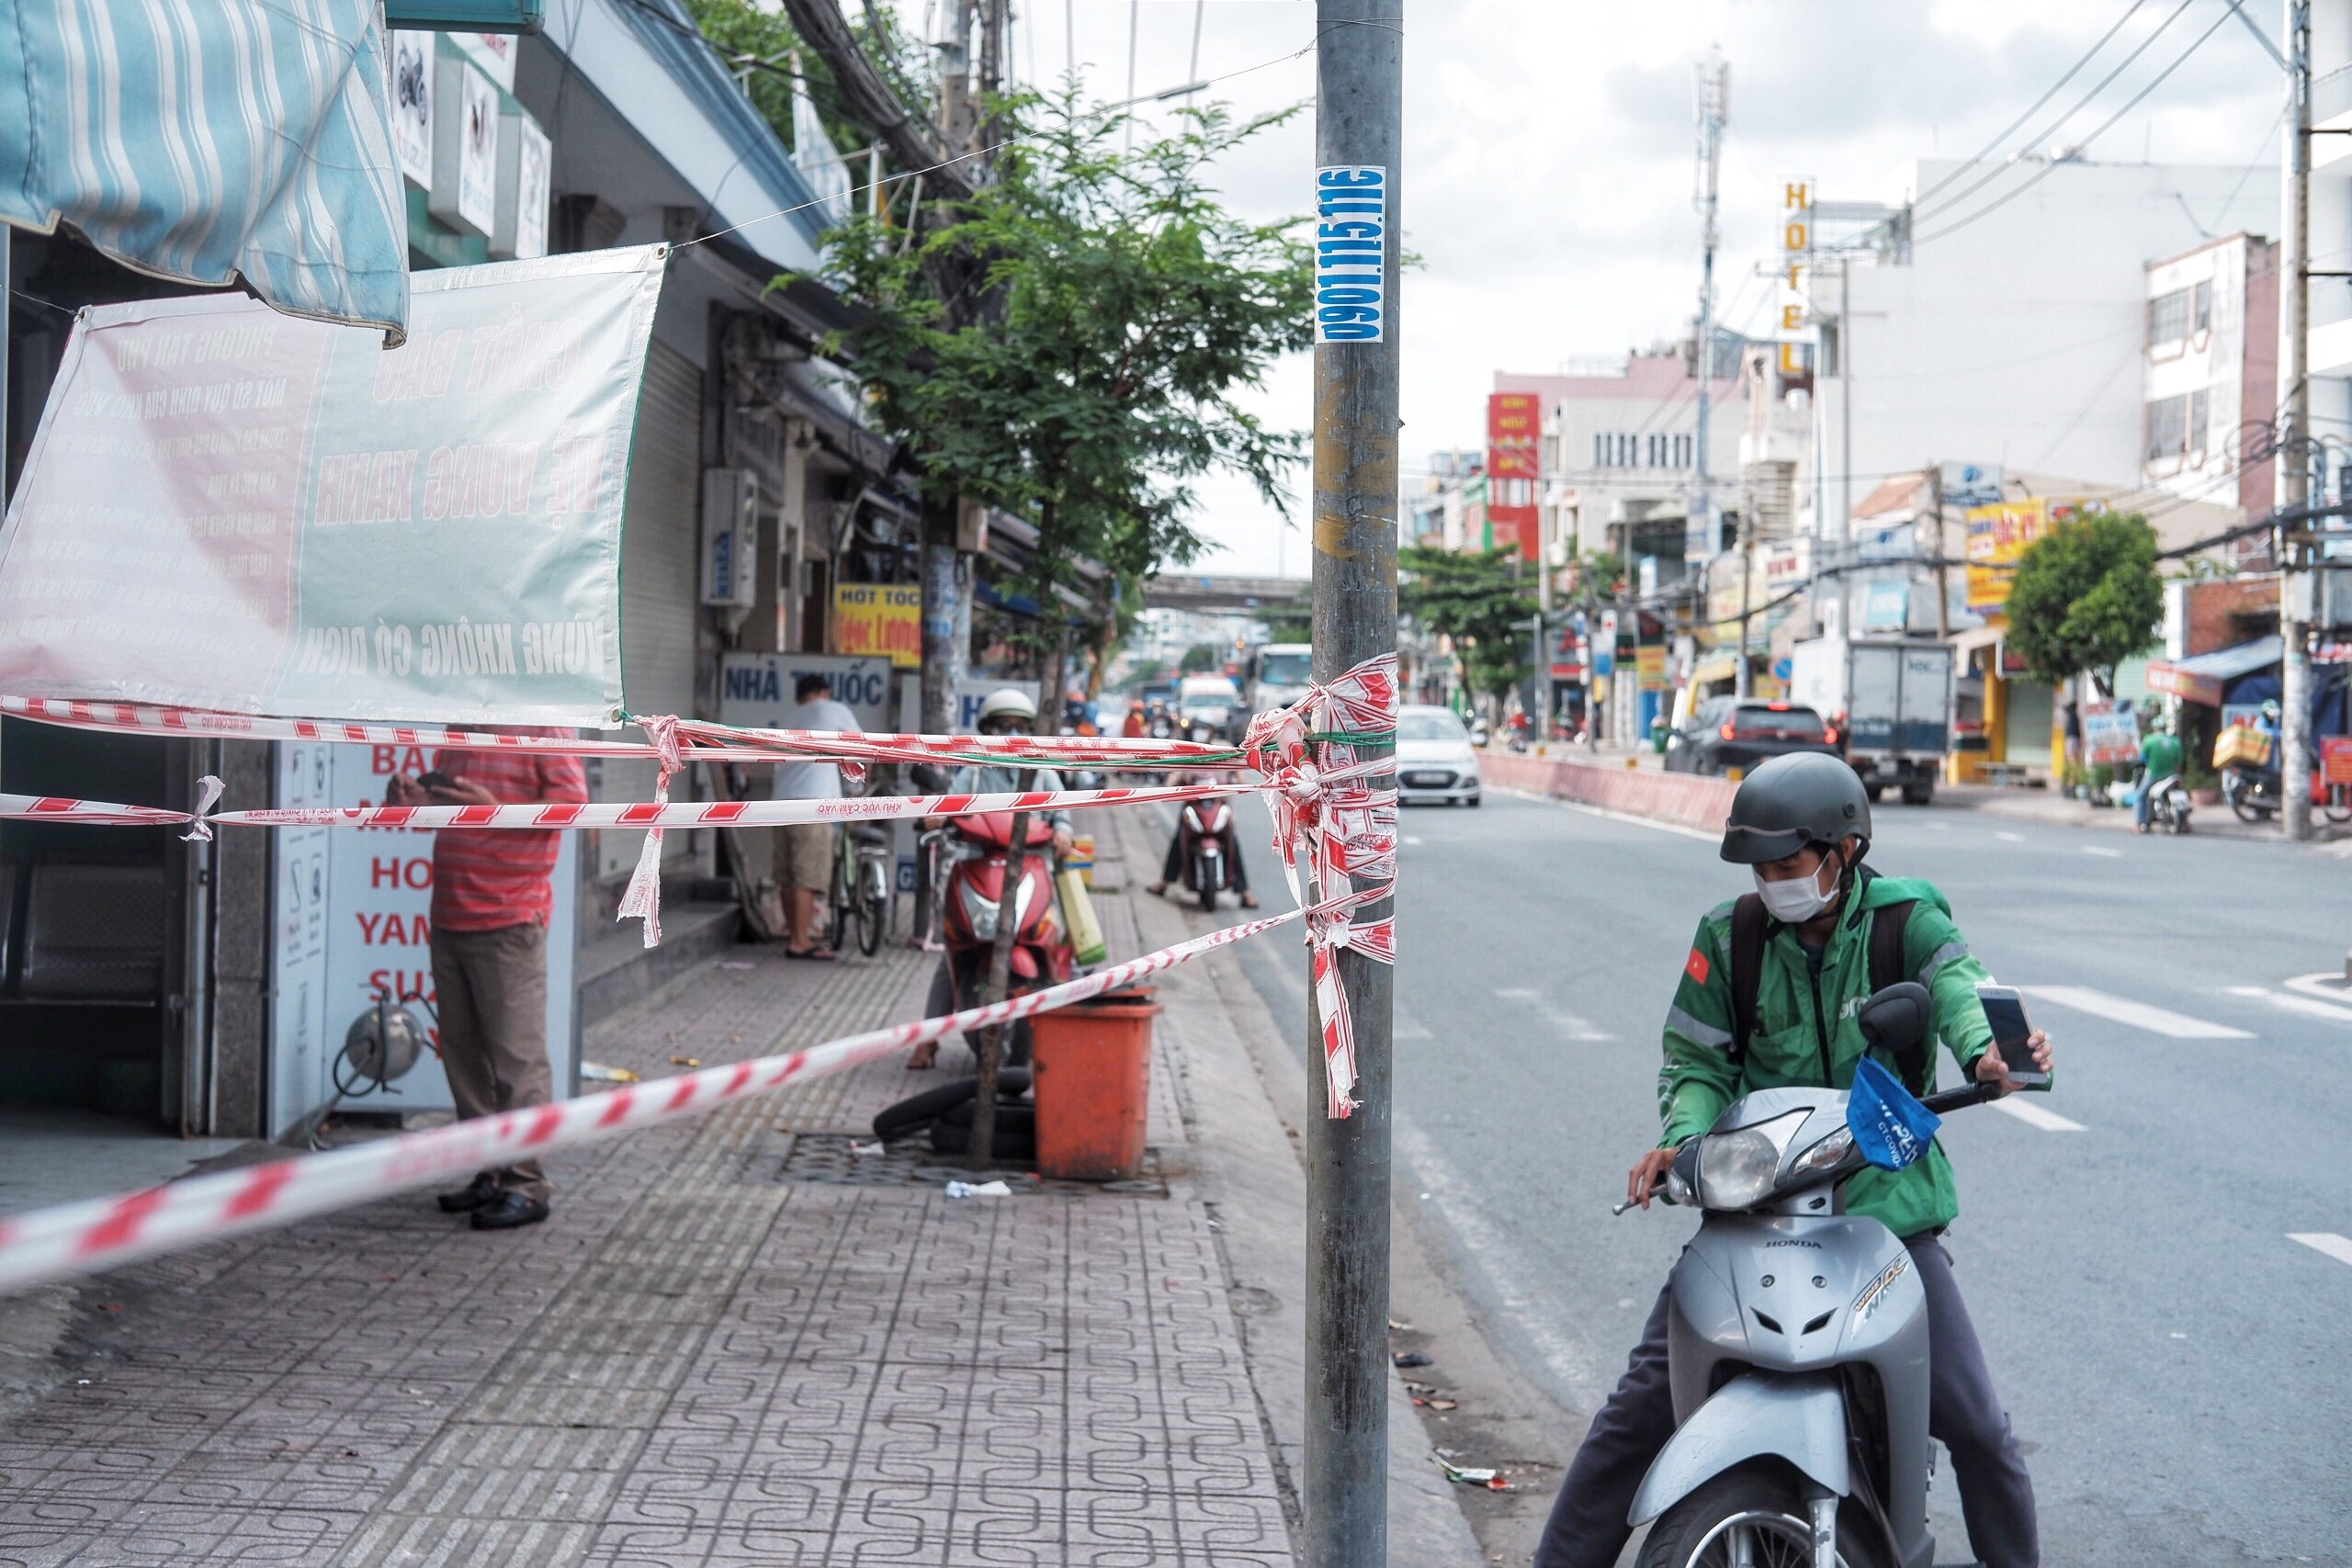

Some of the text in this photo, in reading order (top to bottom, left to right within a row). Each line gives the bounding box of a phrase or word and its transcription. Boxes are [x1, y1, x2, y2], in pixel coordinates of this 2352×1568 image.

[1317, 170, 1383, 340] 0901.115.116
[1781, 182, 1807, 375] HOTEL
[724, 659, 883, 705] NHÀ TUỐC
[371, 858, 435, 889] HO
[1765, 1239, 1823, 1249] HONDA
